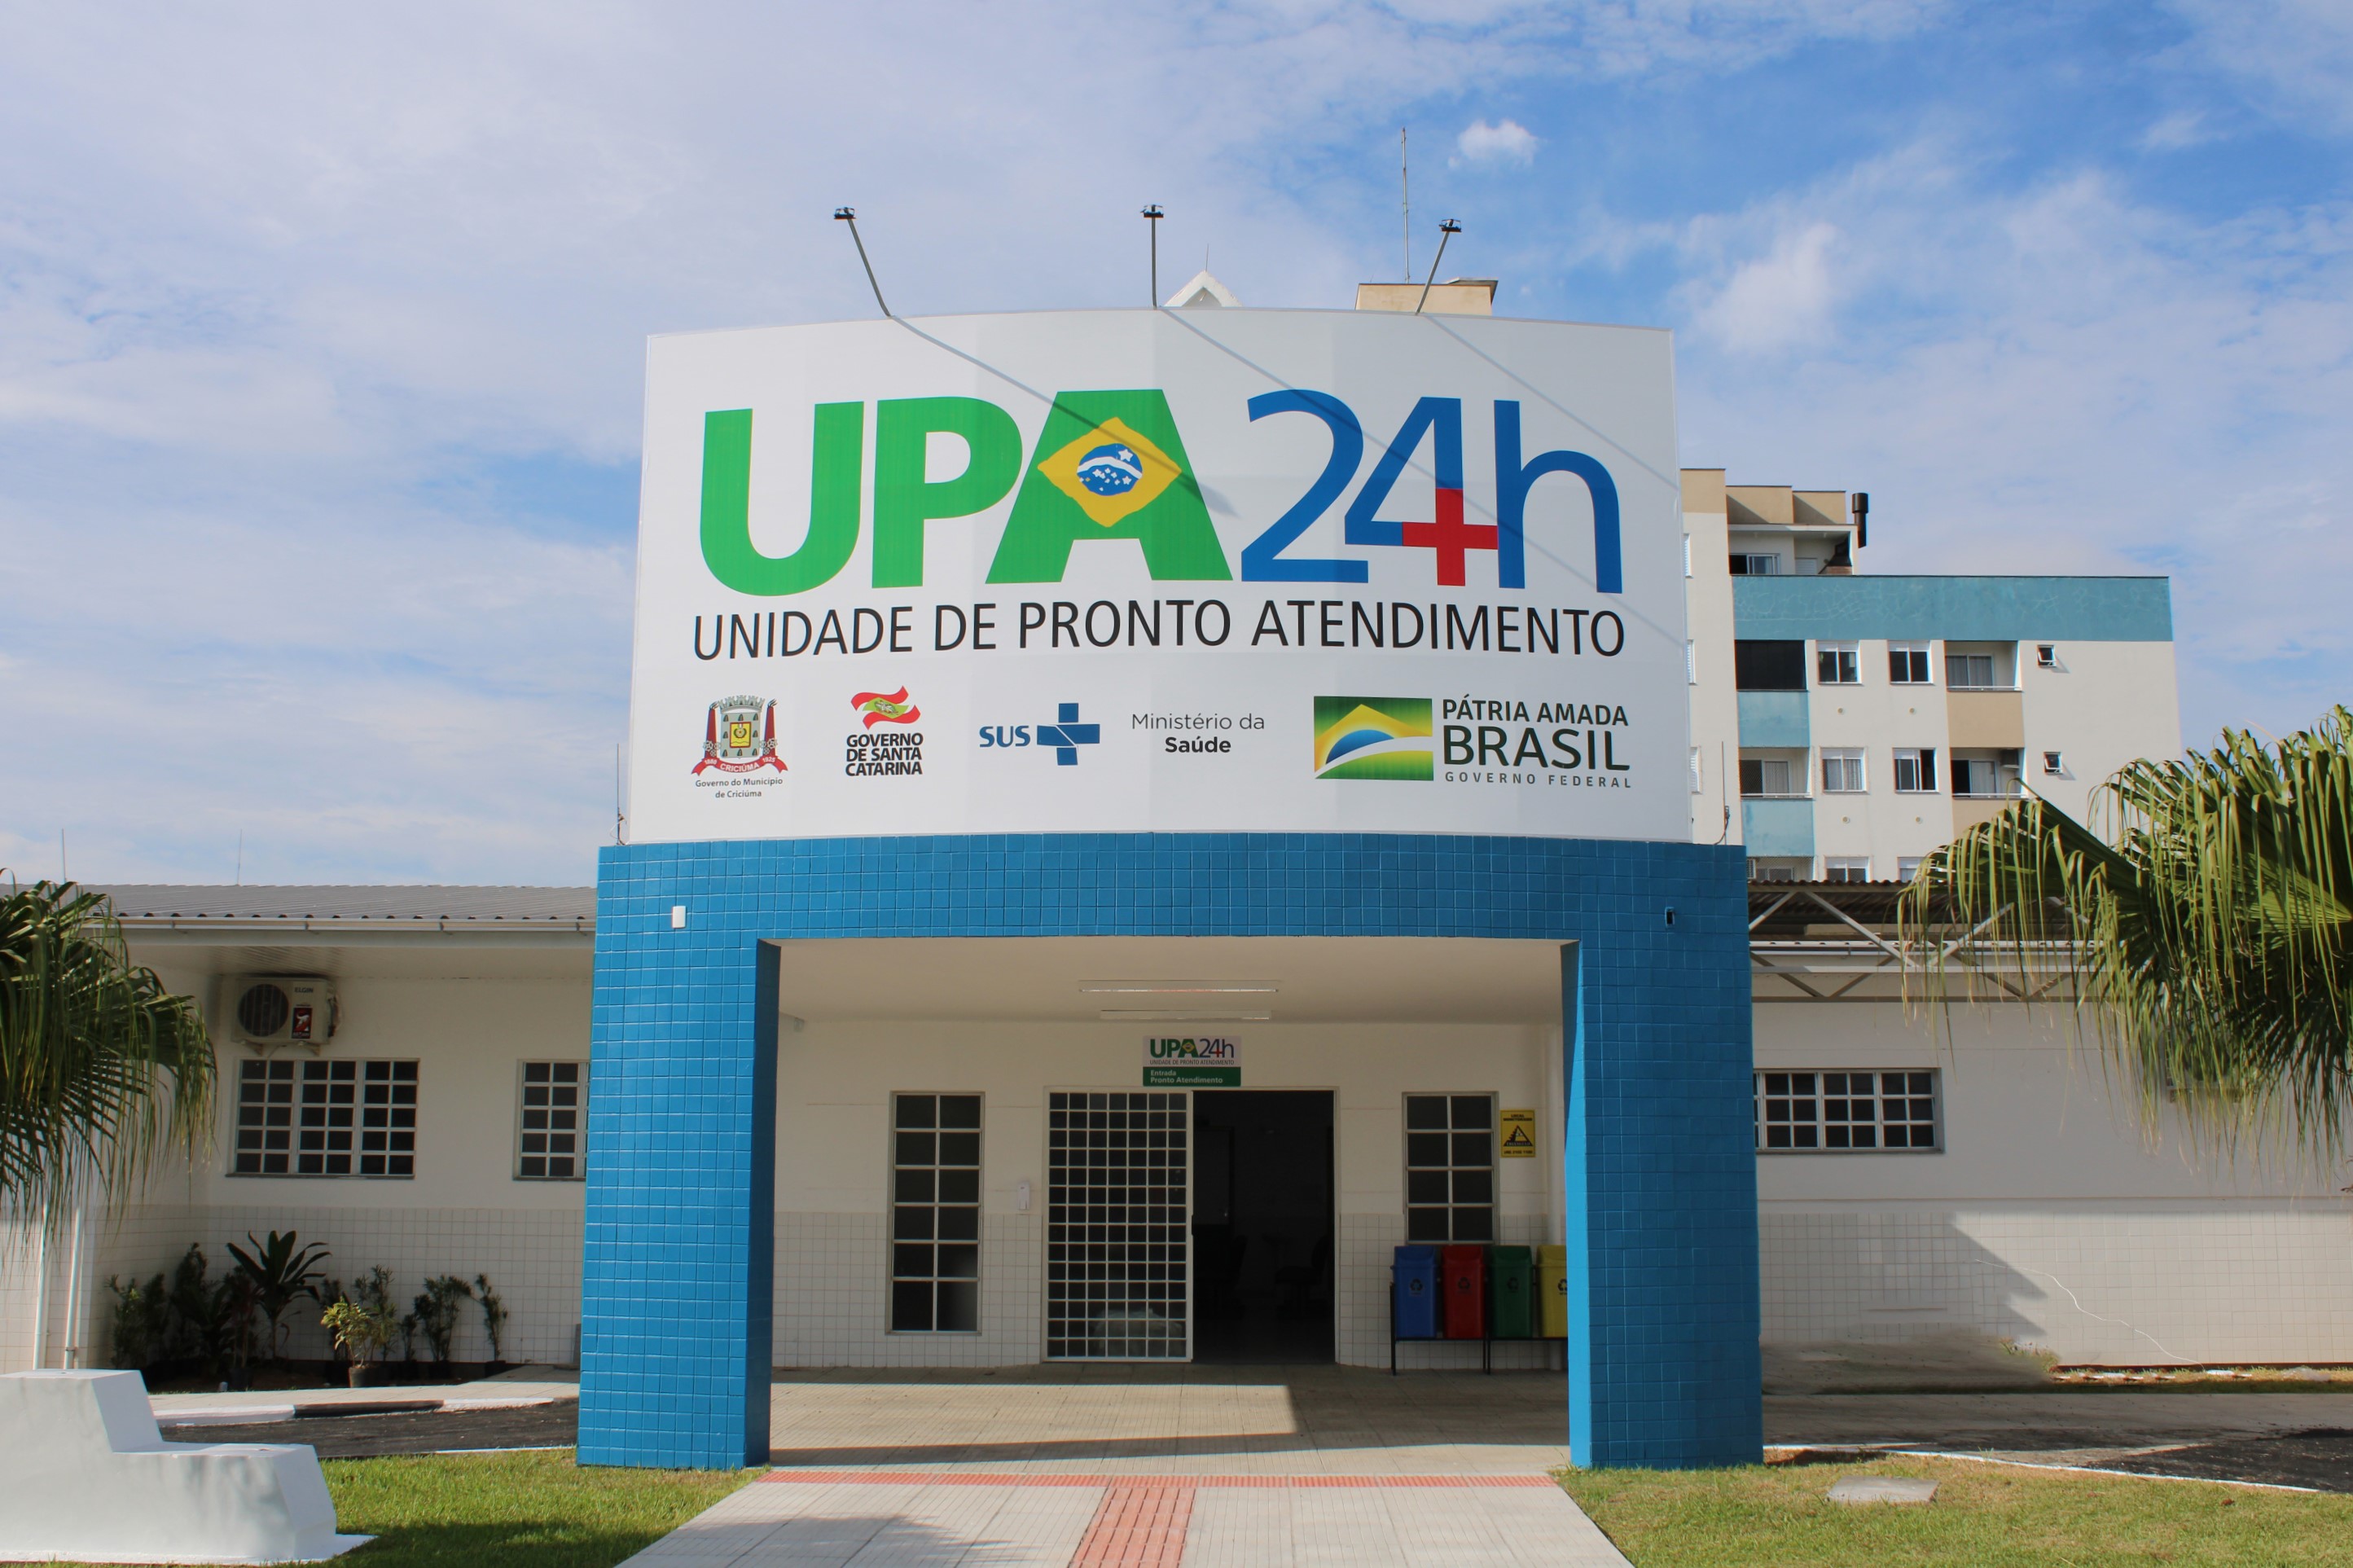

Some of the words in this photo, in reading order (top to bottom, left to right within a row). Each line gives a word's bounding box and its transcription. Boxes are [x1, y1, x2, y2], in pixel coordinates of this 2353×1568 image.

[694, 606, 913, 661] UNIDADE
[934, 603, 996, 652] DE
[1019, 599, 1231, 649] PRONTO
[1251, 600, 1625, 657] ATENDIMENTO
[1442, 694, 1530, 723] PÁTRIA
[1536, 703, 1629, 727] AMADA
[1132, 713, 1232, 730] Ministério
[1239, 713, 1265, 730] da
[846, 732, 924, 747] GOVERNO
[979, 725, 1031, 748] SUS
[1165, 736, 1231, 753] Saúde
[846, 748, 867, 762] DE
[871, 747, 922, 762] SANTA
[1443, 724, 1631, 771] BRASIL
[720, 762, 760, 773] CRICIÚMA
[845, 762, 923, 776] CATARINA
[695, 780, 729, 788] Governo
[731, 778, 742, 786] do
[1445, 771, 1536, 784] GOVERNO
[1548, 775, 1631, 788] FEDERAL
[715, 790, 726, 798] de
[727, 789, 762, 798] Criciúma
